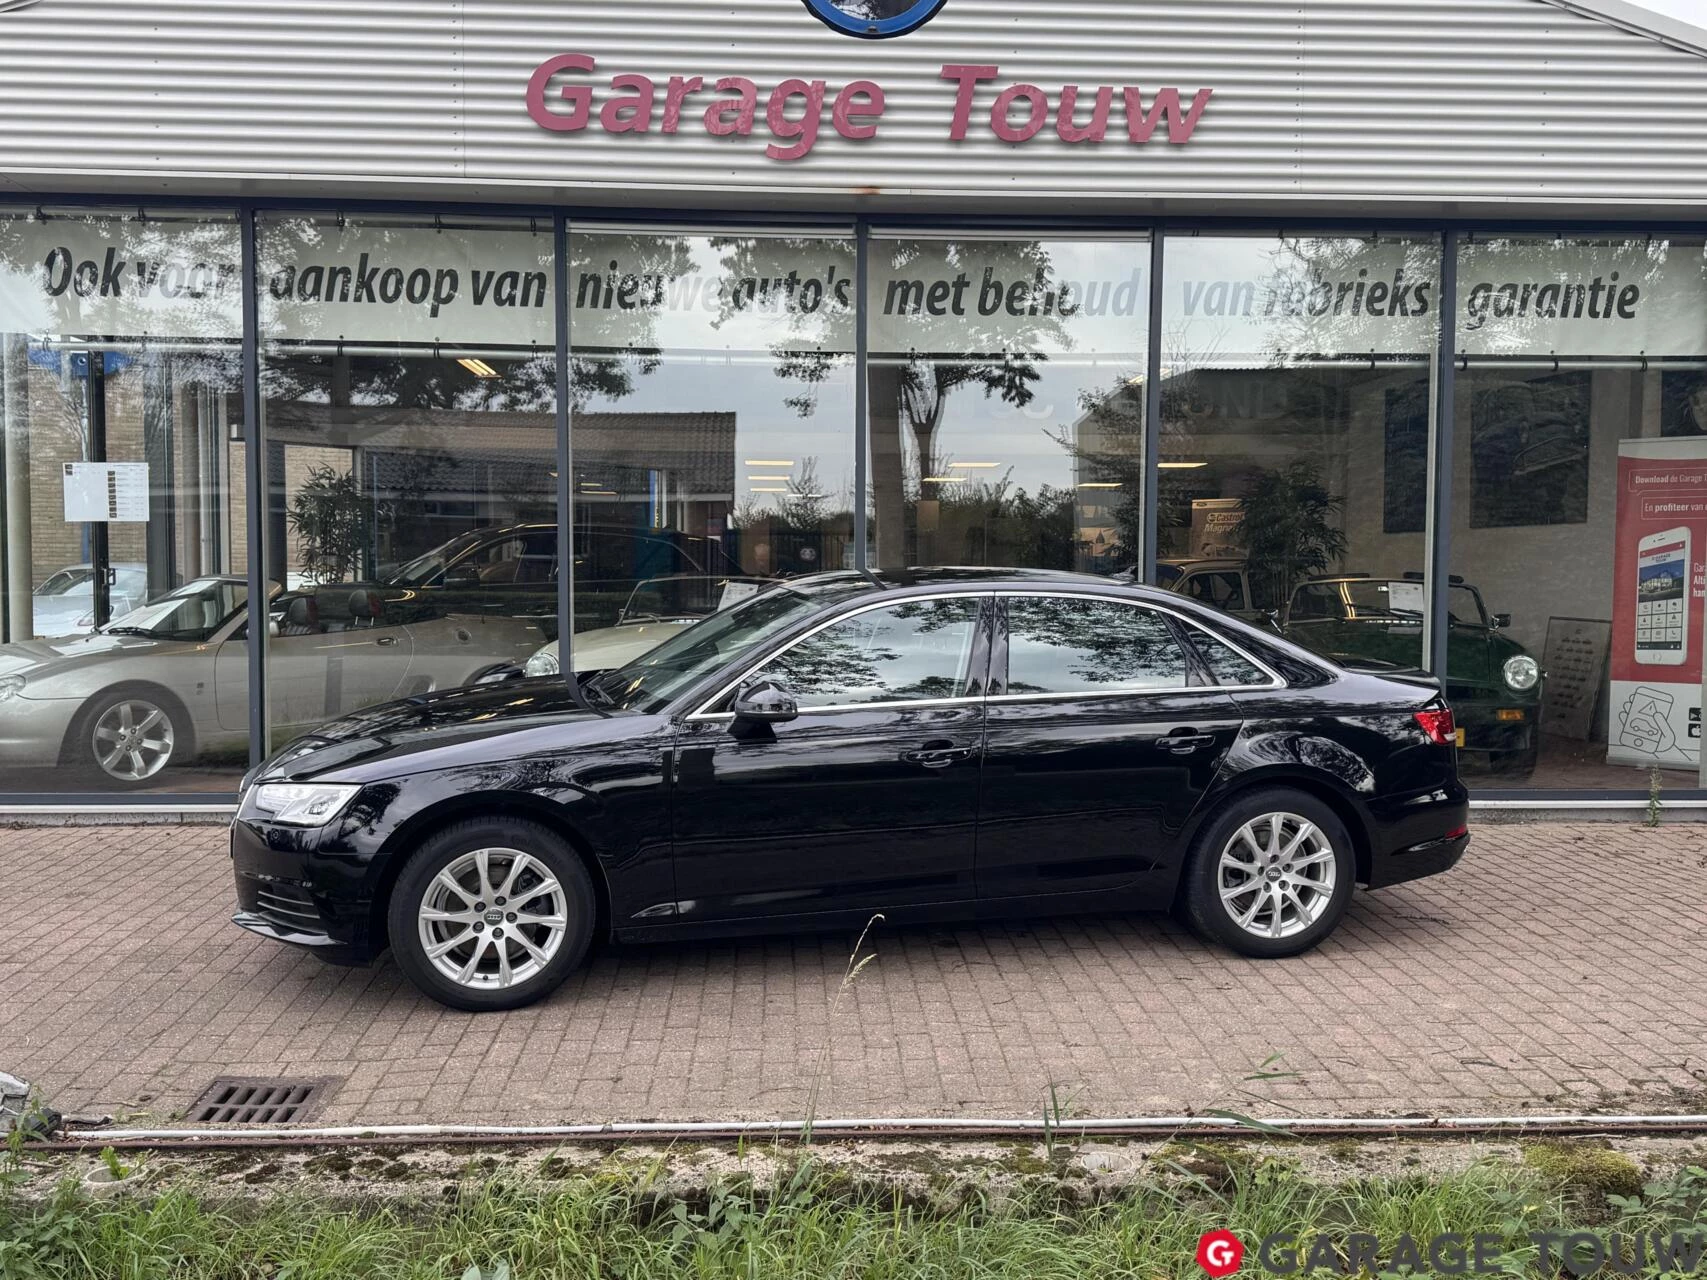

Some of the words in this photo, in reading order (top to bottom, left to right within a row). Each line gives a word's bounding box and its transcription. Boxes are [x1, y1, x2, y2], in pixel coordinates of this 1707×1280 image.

[525, 53, 885, 160] Garage
[940, 64, 1214, 144] Touw
[43, 246, 126, 298] Ook
[136, 261, 236, 299] voor
[270, 252, 459, 318] aankoop
[471, 269, 547, 308] van
[575, 260, 722, 312] nieuwe
[732, 265, 852, 314] auto's
[883, 272, 971, 316] met
[977, 266, 1142, 317] behoud
[1183, 280, 1254, 317] van
[1466, 271, 1640, 331] garantie
[1635, 474, 1669, 484] Download
[1654, 503, 1689, 513] profiteer
[1690, 503, 1704, 511] van
